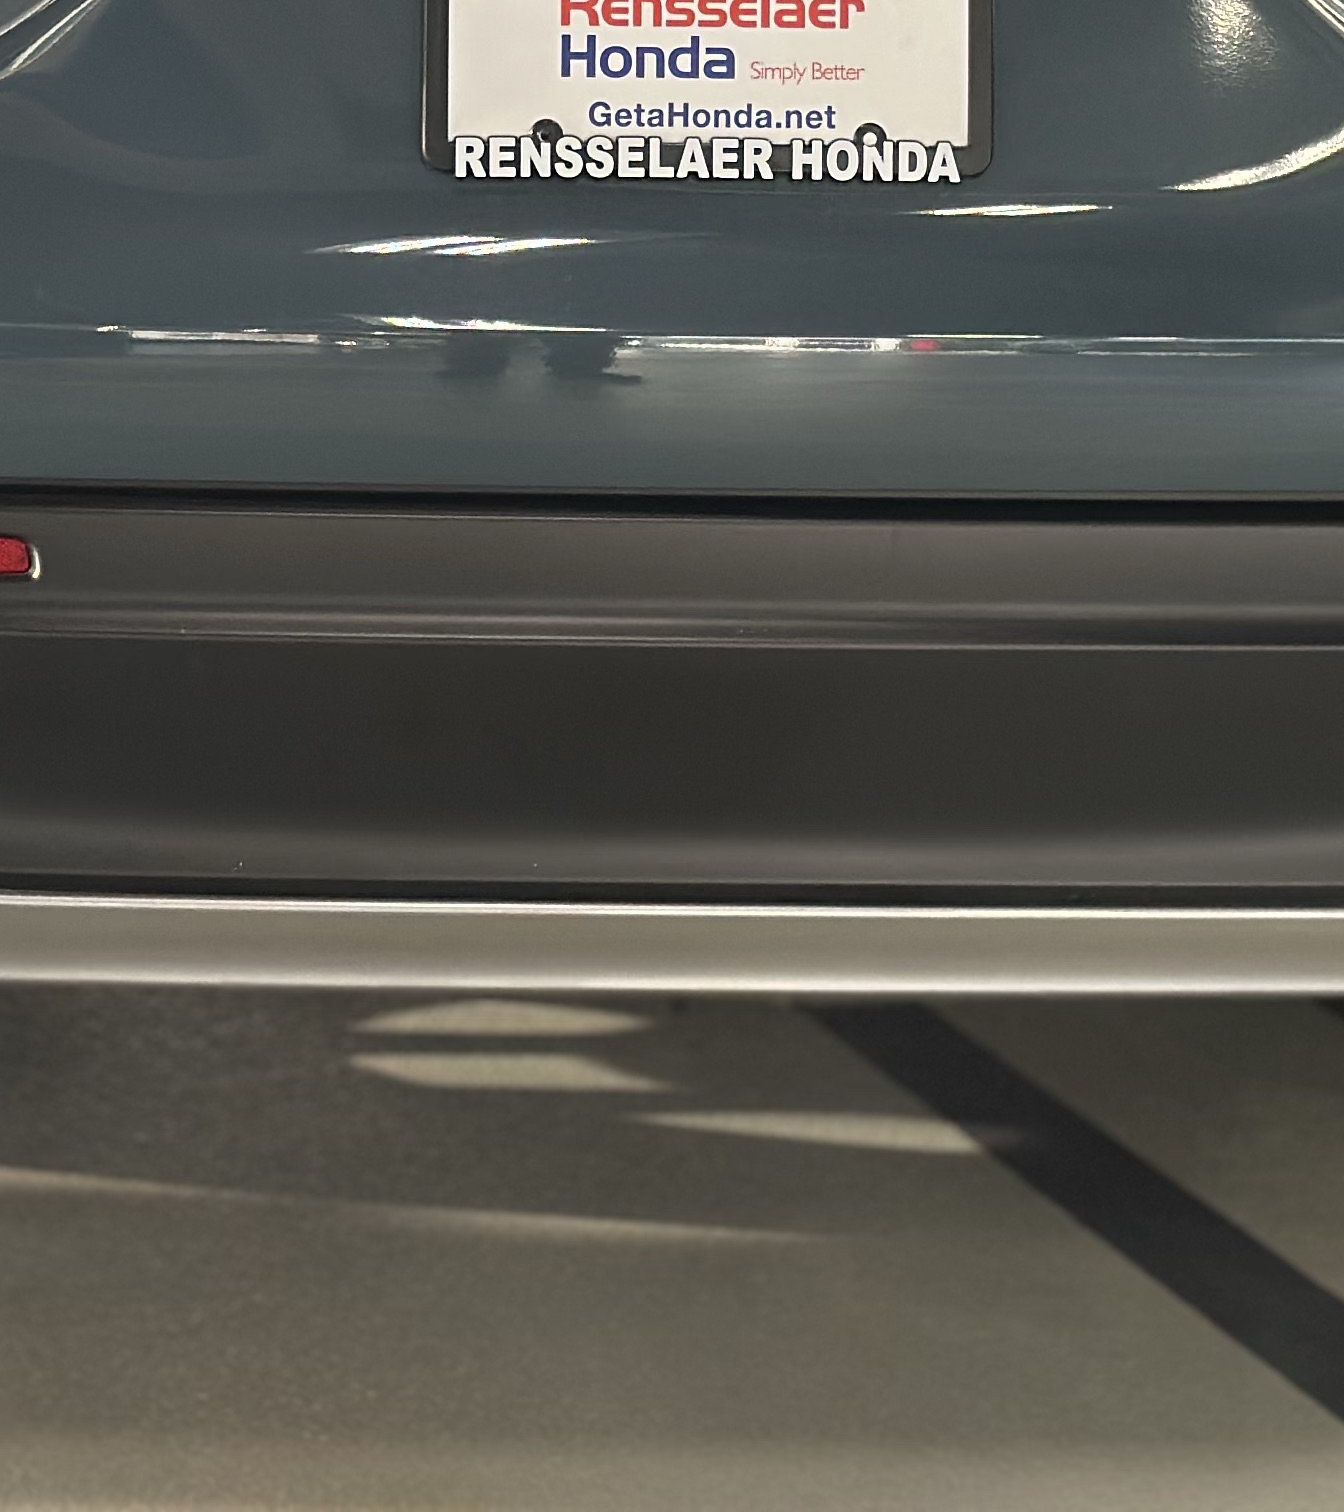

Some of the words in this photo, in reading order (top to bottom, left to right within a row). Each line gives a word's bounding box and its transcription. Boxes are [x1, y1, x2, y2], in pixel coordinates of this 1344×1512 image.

[560, 34, 736, 79] Honda
[749, 59, 807, 87] Simply
[812, 61, 866, 83] Better
[587, 100, 837, 131] GetaHonda.net
[454, 135, 774, 180] RENSSELAER
[792, 138, 961, 184] HONDA
